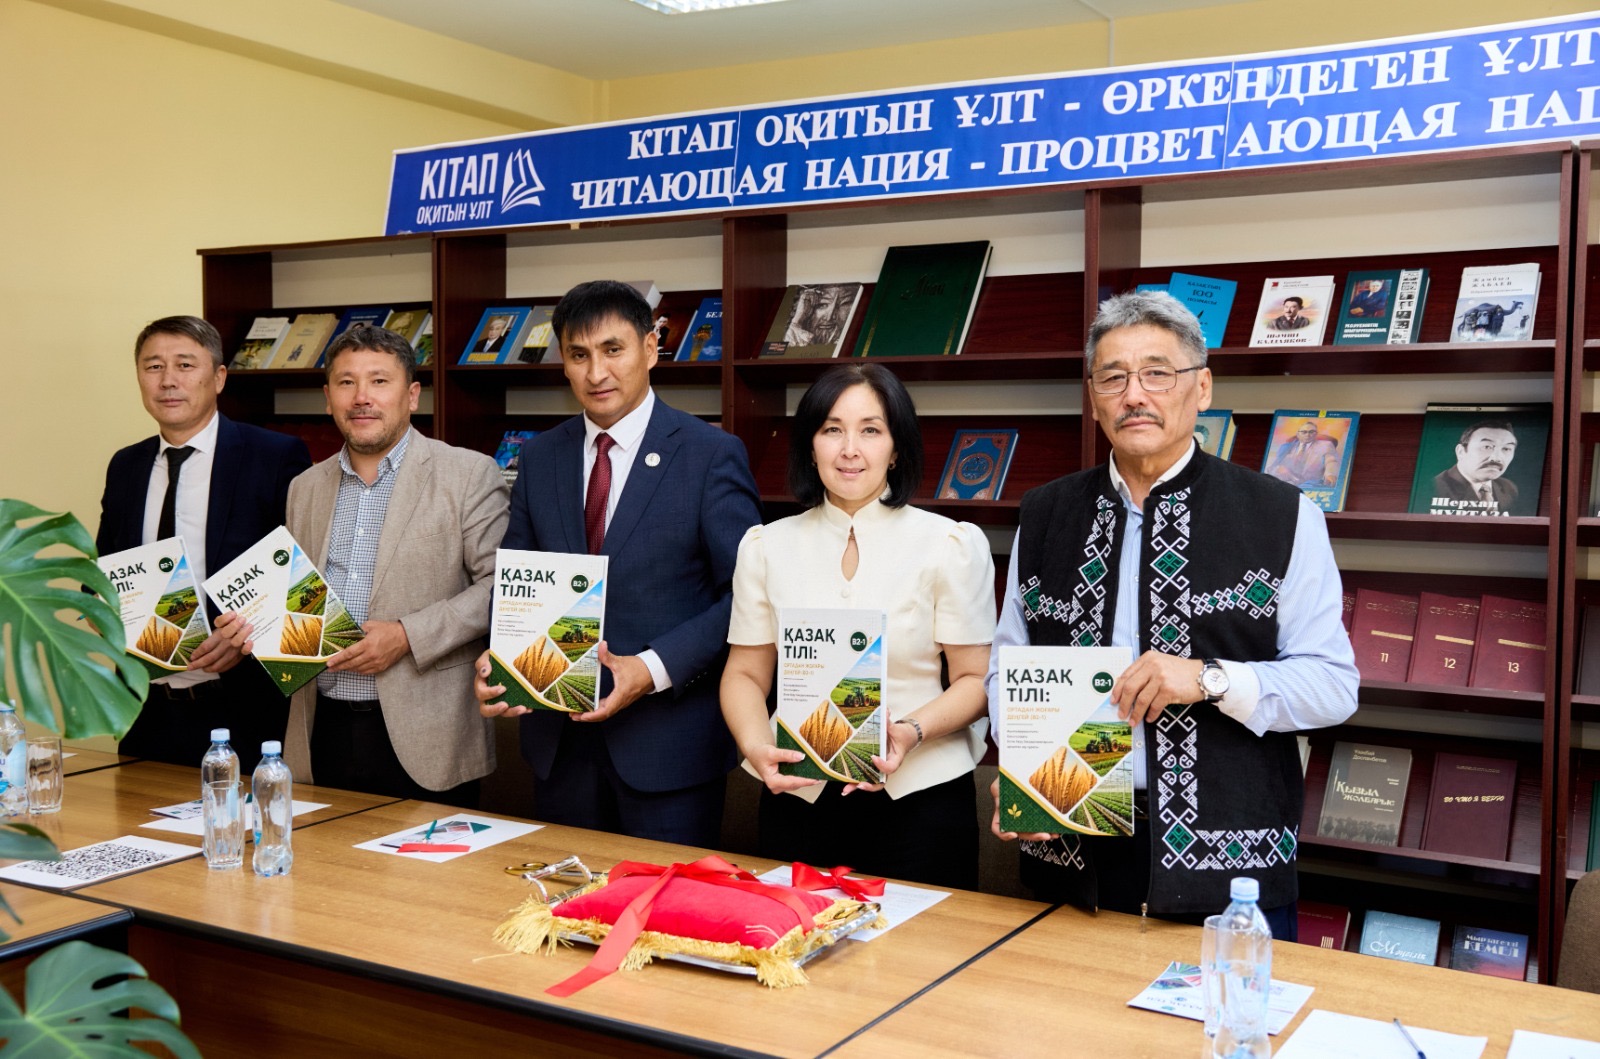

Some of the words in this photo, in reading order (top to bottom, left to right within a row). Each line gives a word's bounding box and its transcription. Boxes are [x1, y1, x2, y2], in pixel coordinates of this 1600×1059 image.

[628, 120, 736, 160] КІТАП
[756, 99, 934, 150] ОҚИТЫН
[953, 88, 1044, 128] ҰЛТ
[1064, 102, 1080, 111] -
[1102, 46, 1452, 115] ӨРКЕНДЕГЕН
[1480, 27, 1600, 76] ҰЛТ
[420, 153, 498, 200] КІТАП
[571, 162, 788, 210] ЧИТАЮЩАЯ
[803, 148, 952, 192] НАЦИЯ
[970, 161, 986, 170] -
[416, 203, 468, 226] ОҚИТЫН
[469, 200, 494, 220] ҰЛТ
[1192, 290, 1213, 298] 100
[1431, 498, 1498, 510] Шерхан
[104, 562, 146, 582] АЗАҚ
[501, 568, 556, 586] ҚАЗАҚ
[116, 582, 134, 593] ЛІ:
[216, 564, 264, 602] ҚАЗАҚ
[500, 584, 536, 598] ТІЛІ:
[226, 588, 258, 611] ТІЛІ:
[784, 628, 836, 644] ҚАЗАҚ
[784, 646, 817, 659] ТІЛІ:
[1380, 652, 1388, 662] 11
[1444, 658, 1456, 669] 12
[1508, 662, 1520, 673] 13
[1006, 668, 1073, 686] ҚАЗАҚ
[1006, 688, 1050, 702] ТІЛІ:
